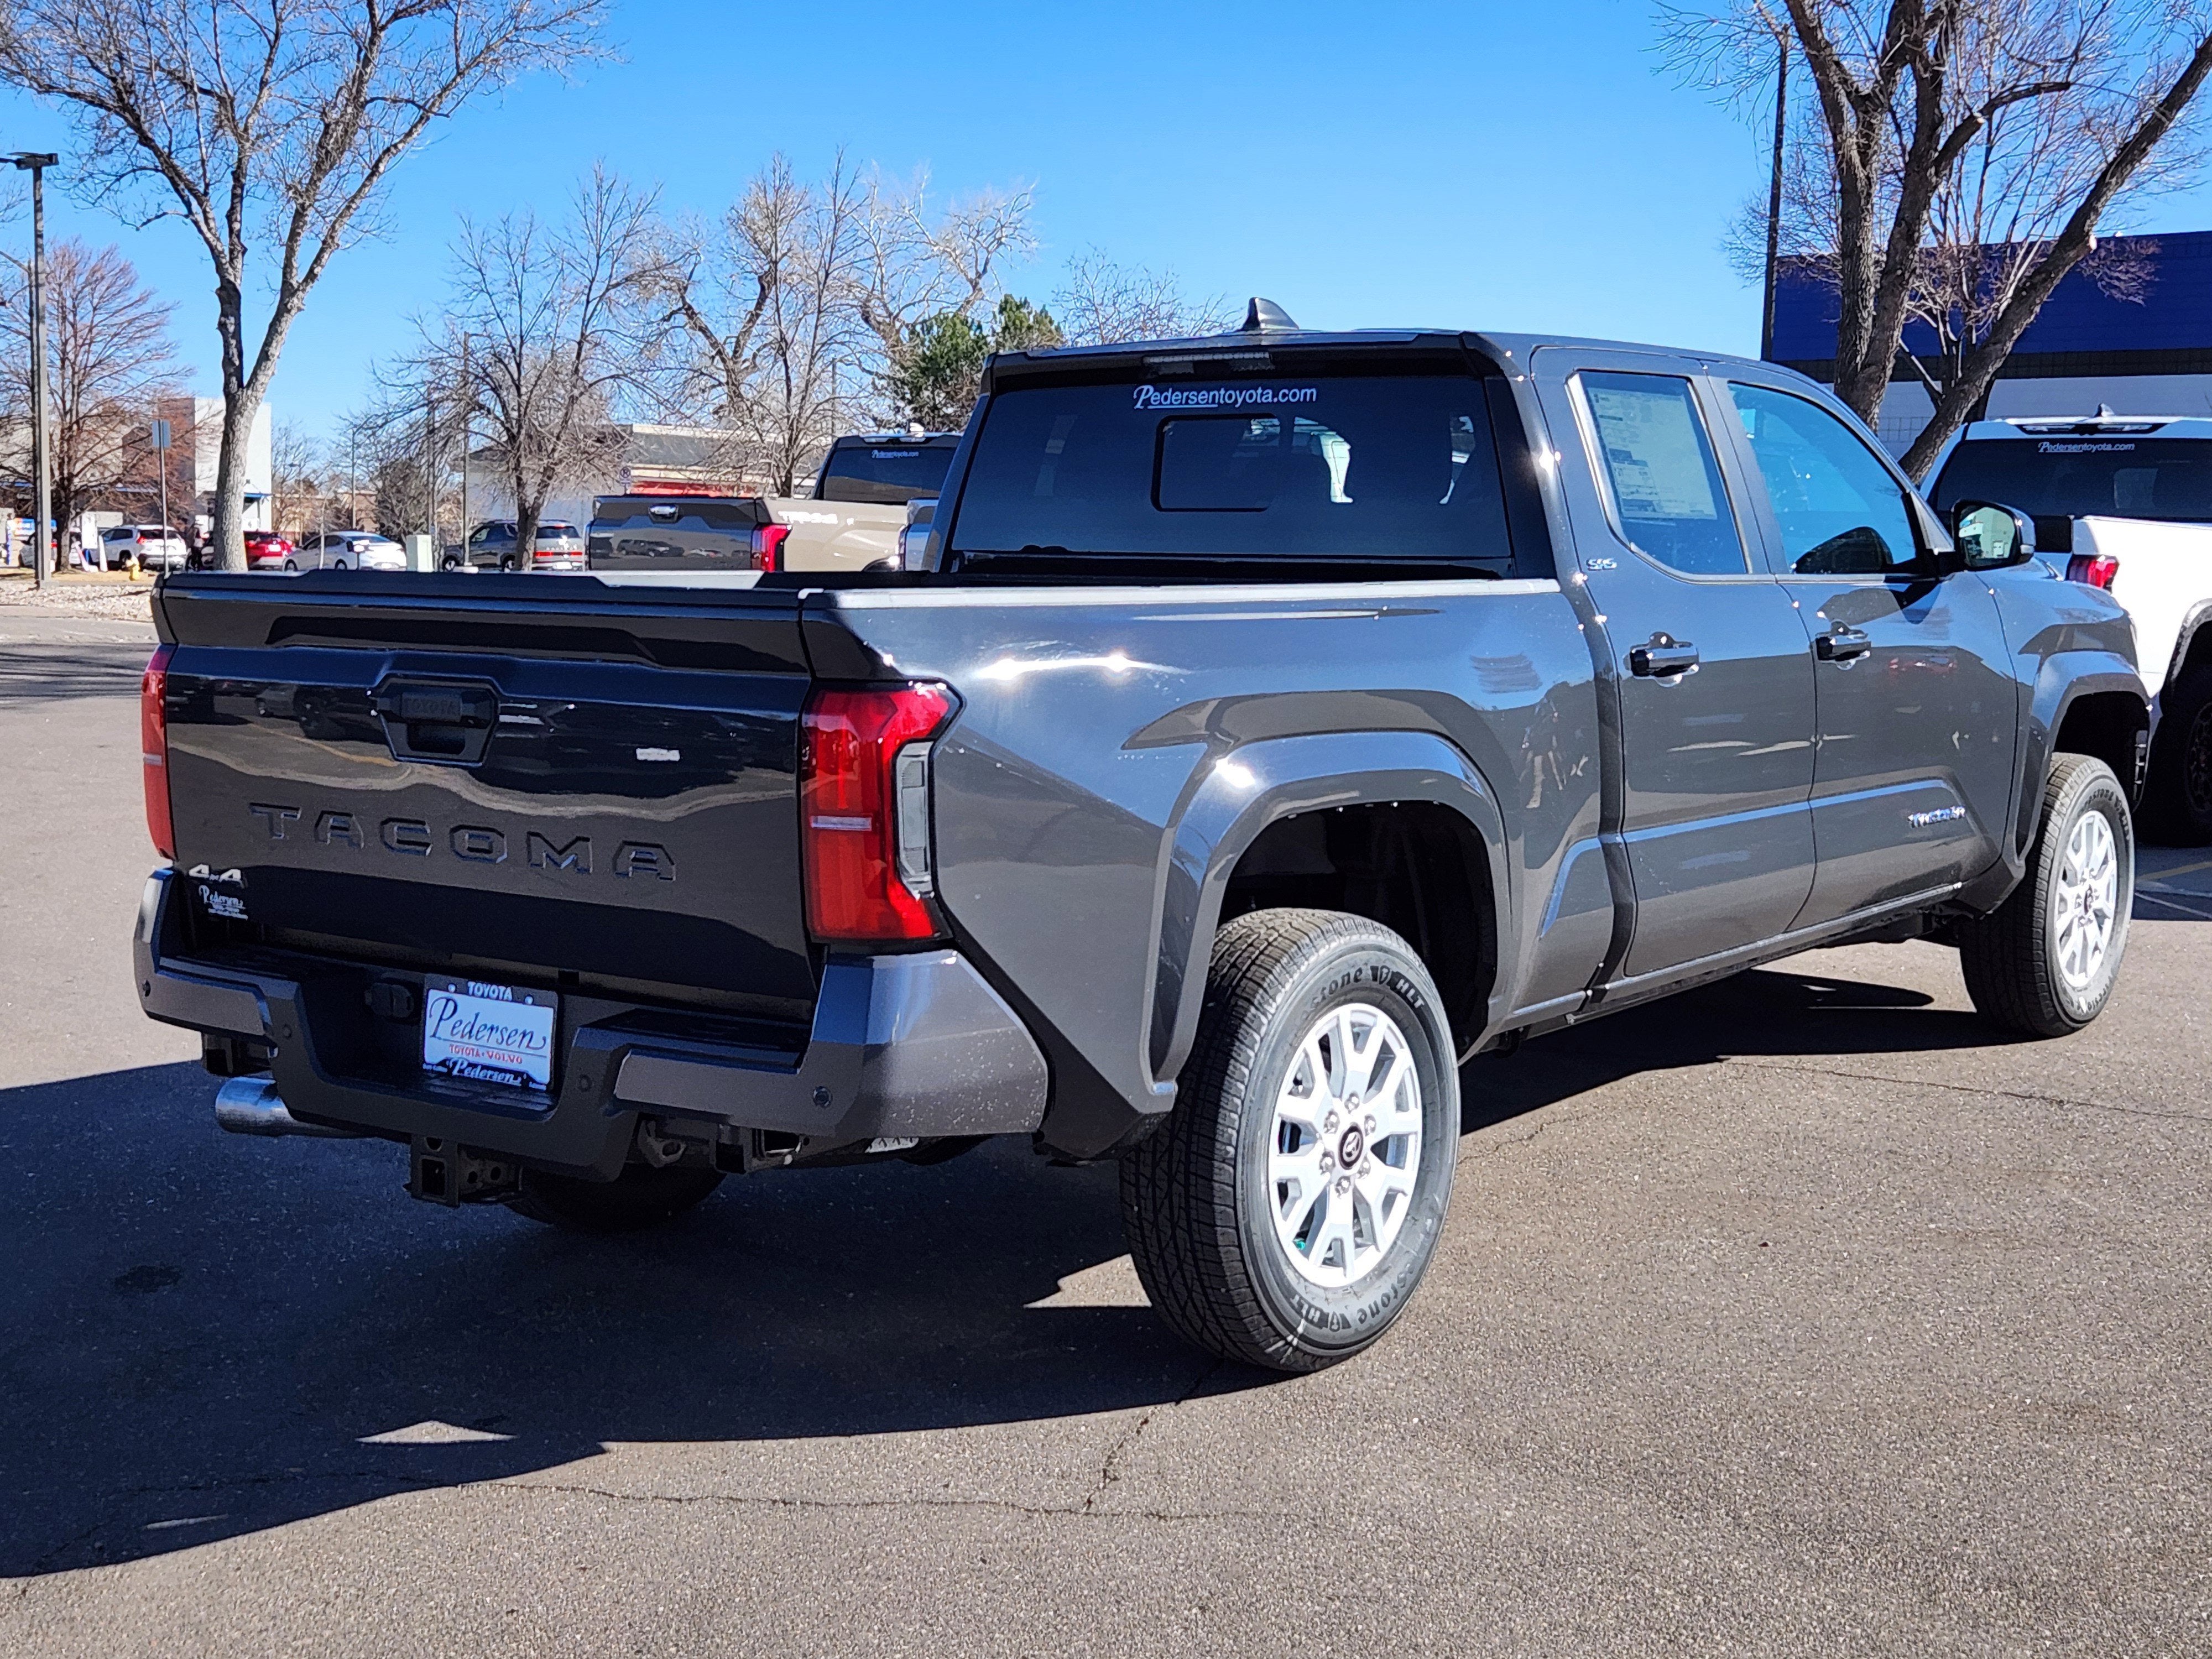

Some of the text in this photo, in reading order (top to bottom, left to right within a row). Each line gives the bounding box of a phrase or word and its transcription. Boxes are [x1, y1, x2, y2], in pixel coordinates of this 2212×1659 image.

[1134, 384, 1317, 409] Pedersentoyota.com
[2038, 441, 2135, 453] Pedersentoyota.com
[249, 802, 677, 881] TACOMA
[467, 980, 513, 1001] TOYOTA
[1395, 978, 1425, 1009] HLT
[429, 997, 547, 1050] Pedersen
[450, 1058, 523, 1087] Pedersen
